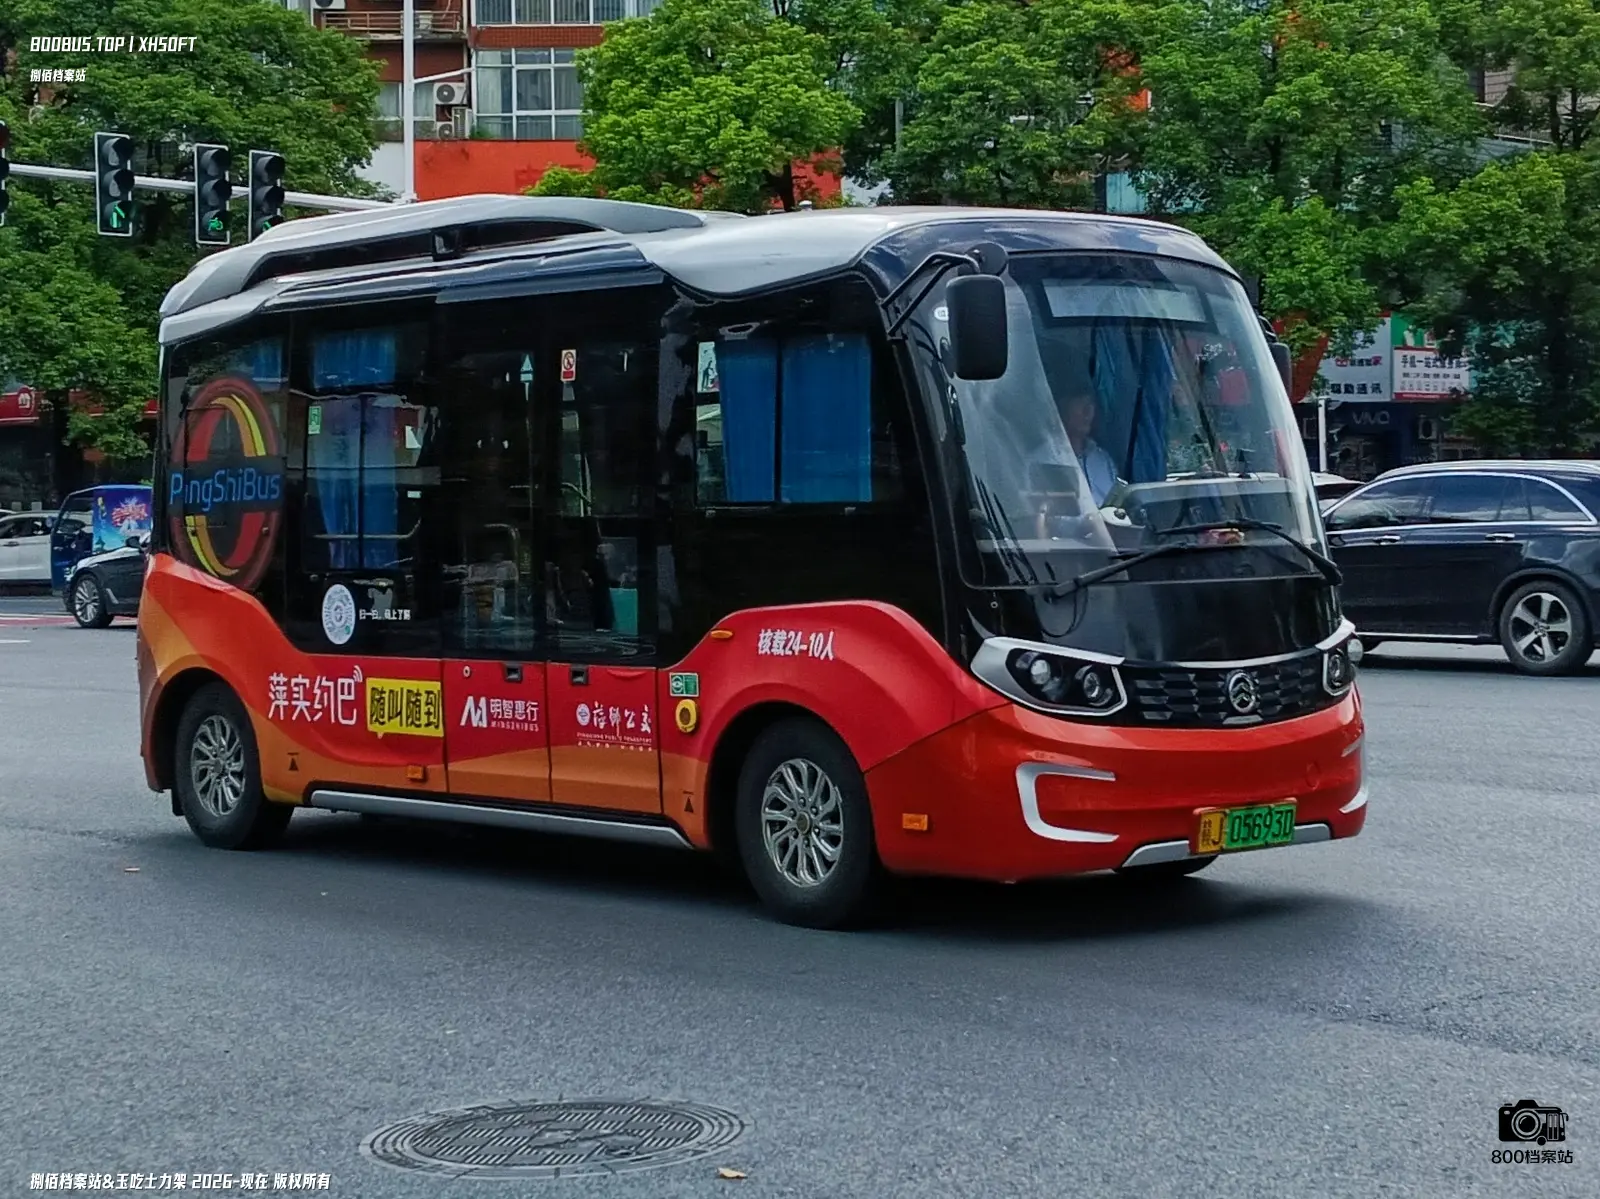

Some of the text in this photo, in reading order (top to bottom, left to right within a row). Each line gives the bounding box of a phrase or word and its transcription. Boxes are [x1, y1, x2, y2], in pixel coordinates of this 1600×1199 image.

[169, 467, 282, 513] PingShiBus
[757, 628, 835, 661] 核载24-10人
[368, 686, 442, 730] 随叫随到
[489, 698, 539, 722] 明智惠行
